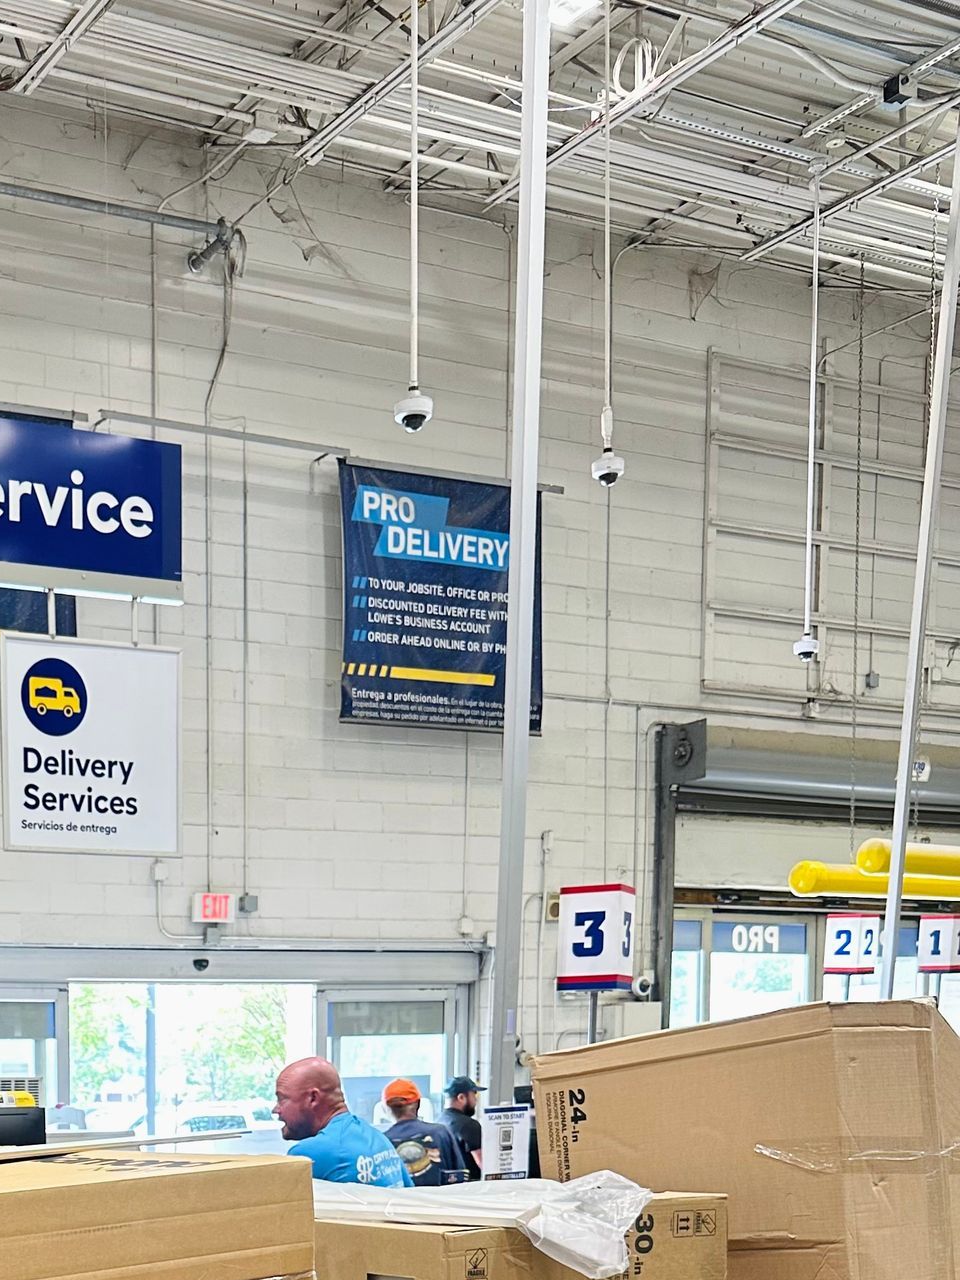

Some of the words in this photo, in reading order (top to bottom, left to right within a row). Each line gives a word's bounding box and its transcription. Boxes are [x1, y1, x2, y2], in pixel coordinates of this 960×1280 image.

[363, 491, 415, 524] PRO
[387, 525, 509, 567] DELIVERY
[368, 577, 379, 589] TO
[380, 579, 405, 592] YOUR
[407, 583, 445, 597] JOBSITE,
[447, 587, 476, 600] OFFICE
[478, 590, 490, 602] OR
[368, 596, 425, 613] DISCOUNTED
[426, 602, 468, 618] DELIVERY
[470, 607, 486, 620] FEE
[368, 612, 402, 626] LOWE'S
[404, 616, 448, 630] BUSINESS
[449, 621, 491, 634] ACCOUNT
[367, 631, 399, 645] ORDER
[401, 635, 432, 648] AHEAD
[433, 637, 466, 651] ONLINE
[467, 641, 480, 652] OR
[482, 642, 493, 653] BY
[352, 687, 385, 702] Entrega
[23, 747, 134, 785] Delivery
[23, 783, 138, 816] Services
[21, 819, 64, 831] Servicios
[66, 822, 78, 832] de
[80, 824, 117, 835] entrega
[202, 894, 229, 919] EXIT
[572, 911, 606, 957] 3
[622, 911, 632, 957] 3
[834, 929, 852, 955] 2
[863, 929, 874, 955] 2
[930, 930, 941, 955] 1
[559, 1091, 567, 1133] DIAGONAL
[562, 1136, 570, 1171] CORNER
